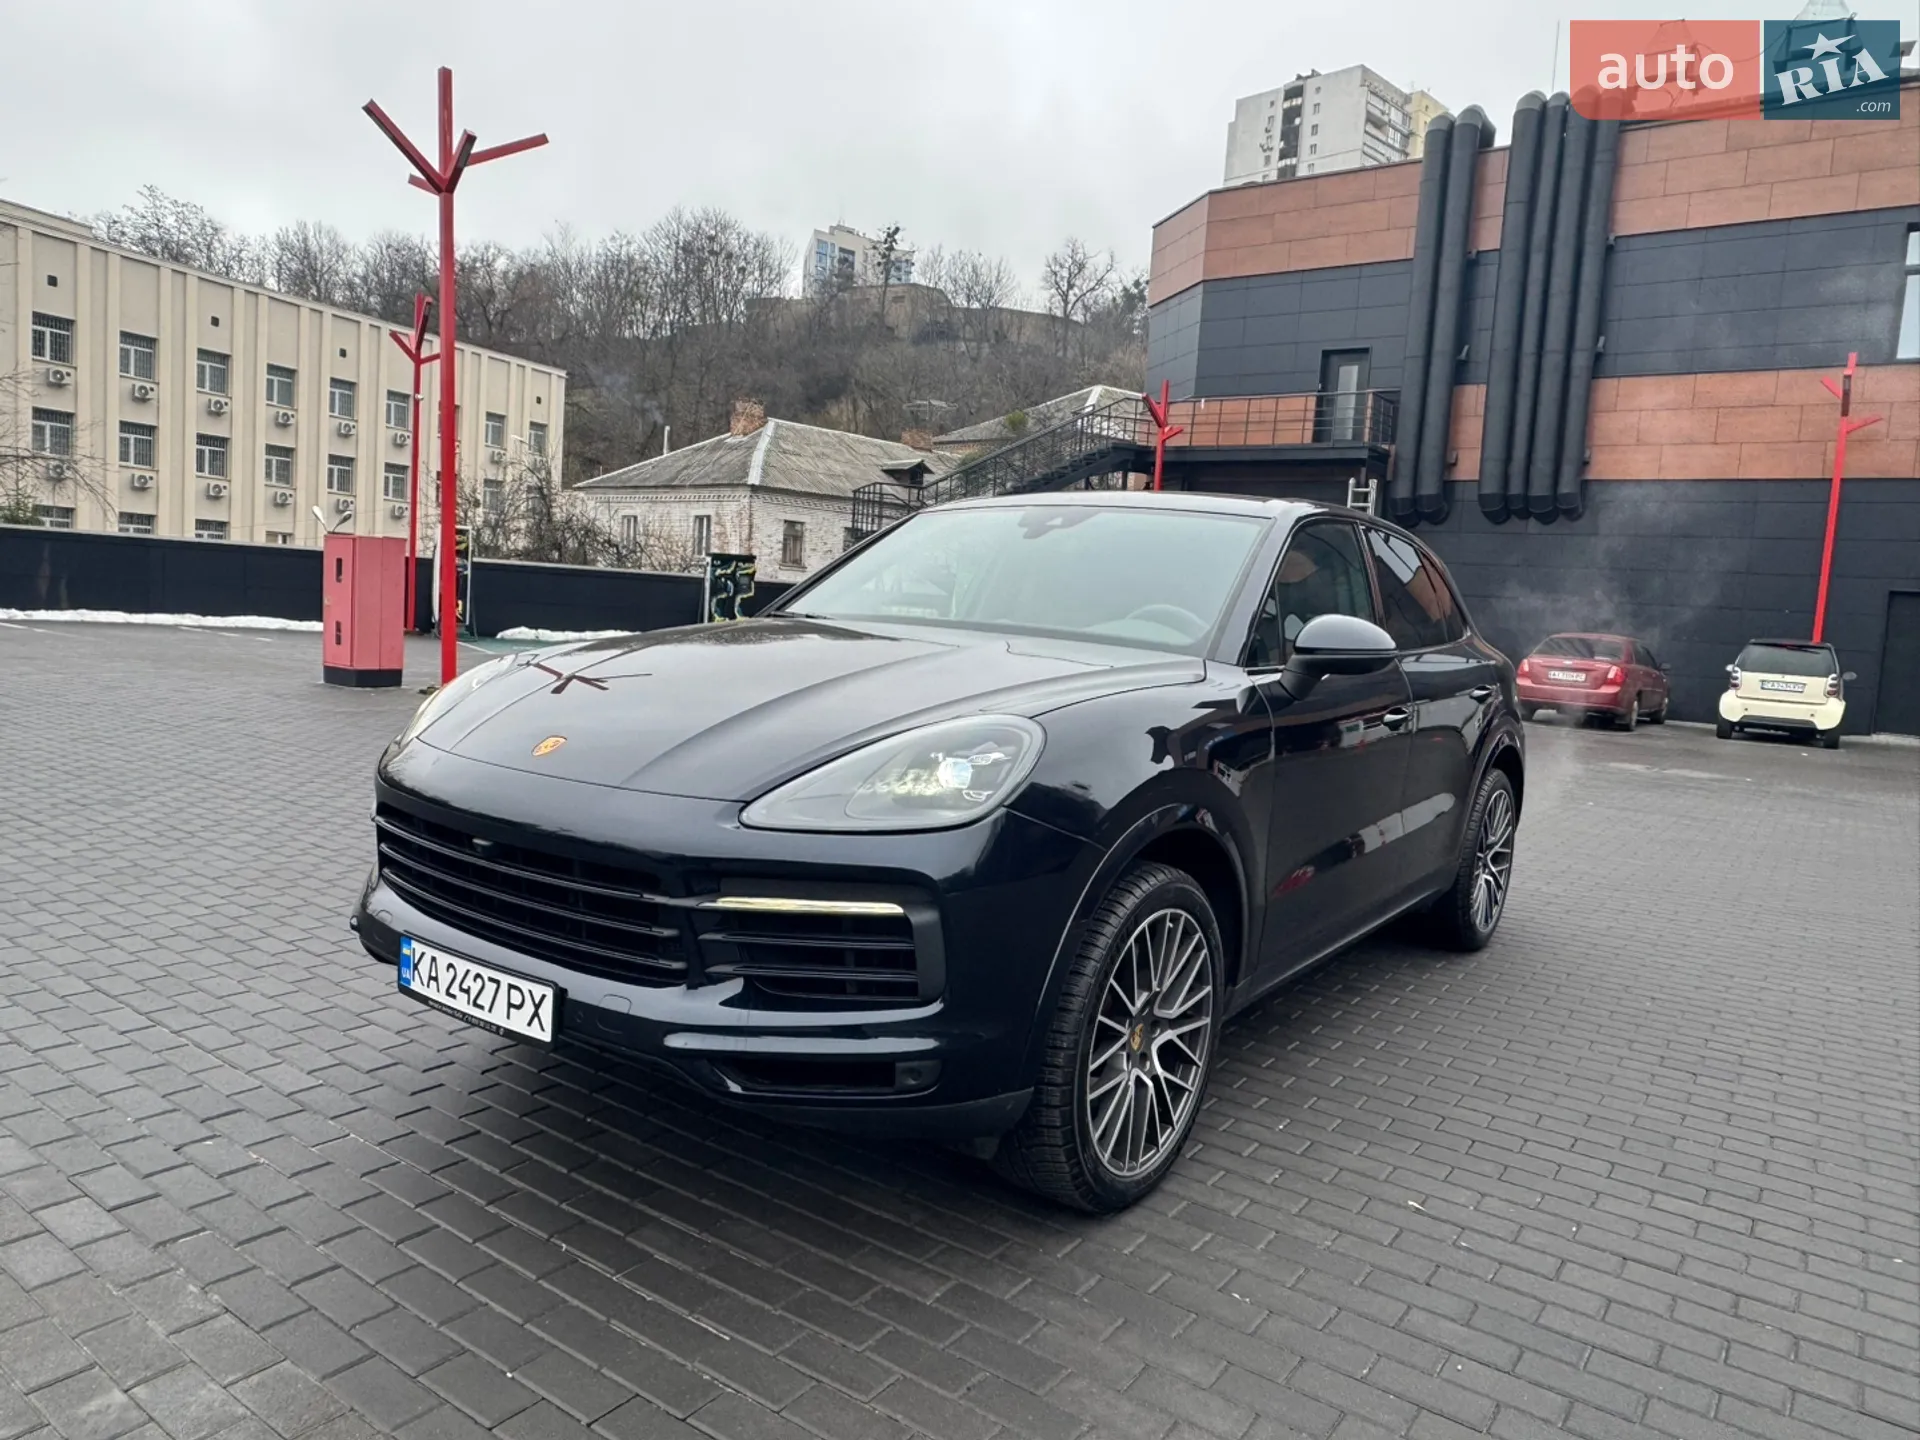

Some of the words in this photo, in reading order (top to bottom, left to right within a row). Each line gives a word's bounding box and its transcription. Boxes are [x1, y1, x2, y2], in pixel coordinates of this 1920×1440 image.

[412, 947, 440, 993] KA
[445, 962, 502, 1014] 2427
[506, 982, 548, 1032] PX
